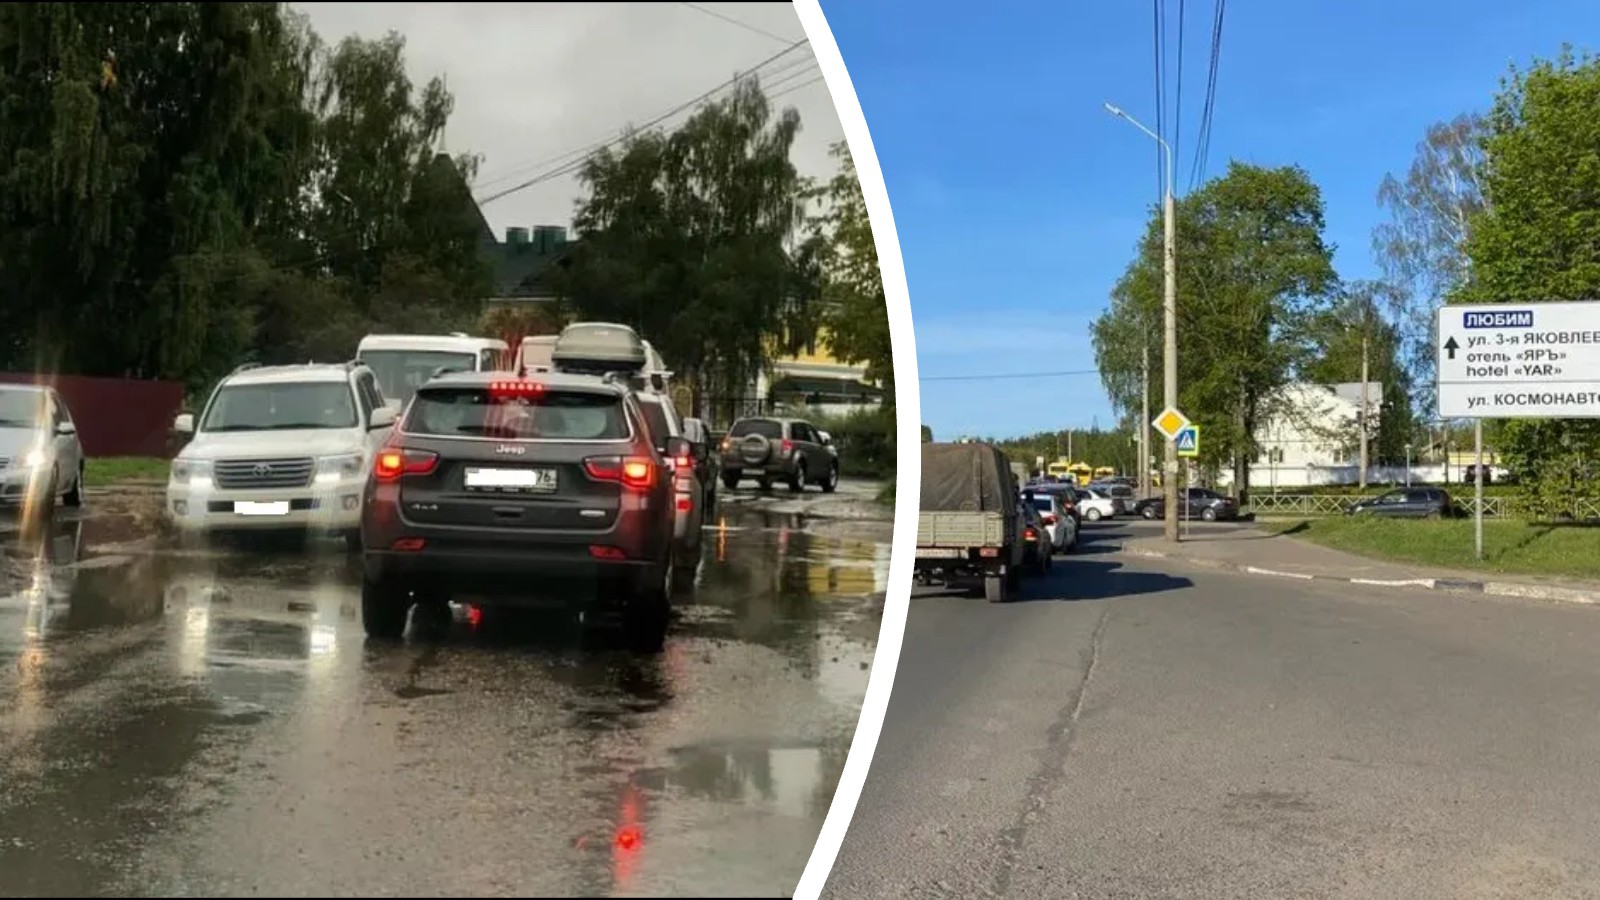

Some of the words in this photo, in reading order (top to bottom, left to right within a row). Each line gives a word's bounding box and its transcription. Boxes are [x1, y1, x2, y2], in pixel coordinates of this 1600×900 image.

[1466, 313, 1531, 326] ЛЮБИМ
[1467, 336, 1490, 348] ул.
[1496, 333, 1519, 345] 3-я
[1466, 352, 1511, 363] отель
[1516, 349, 1567, 361] «ЯРЪ»
[1466, 365, 1509, 377] hotel
[1514, 364, 1562, 376] «YAR»
[1467, 396, 1490, 408] ул.
[1494, 393, 1600, 406] КОСМОНАВТ
[495, 443, 526, 455] Jeep
